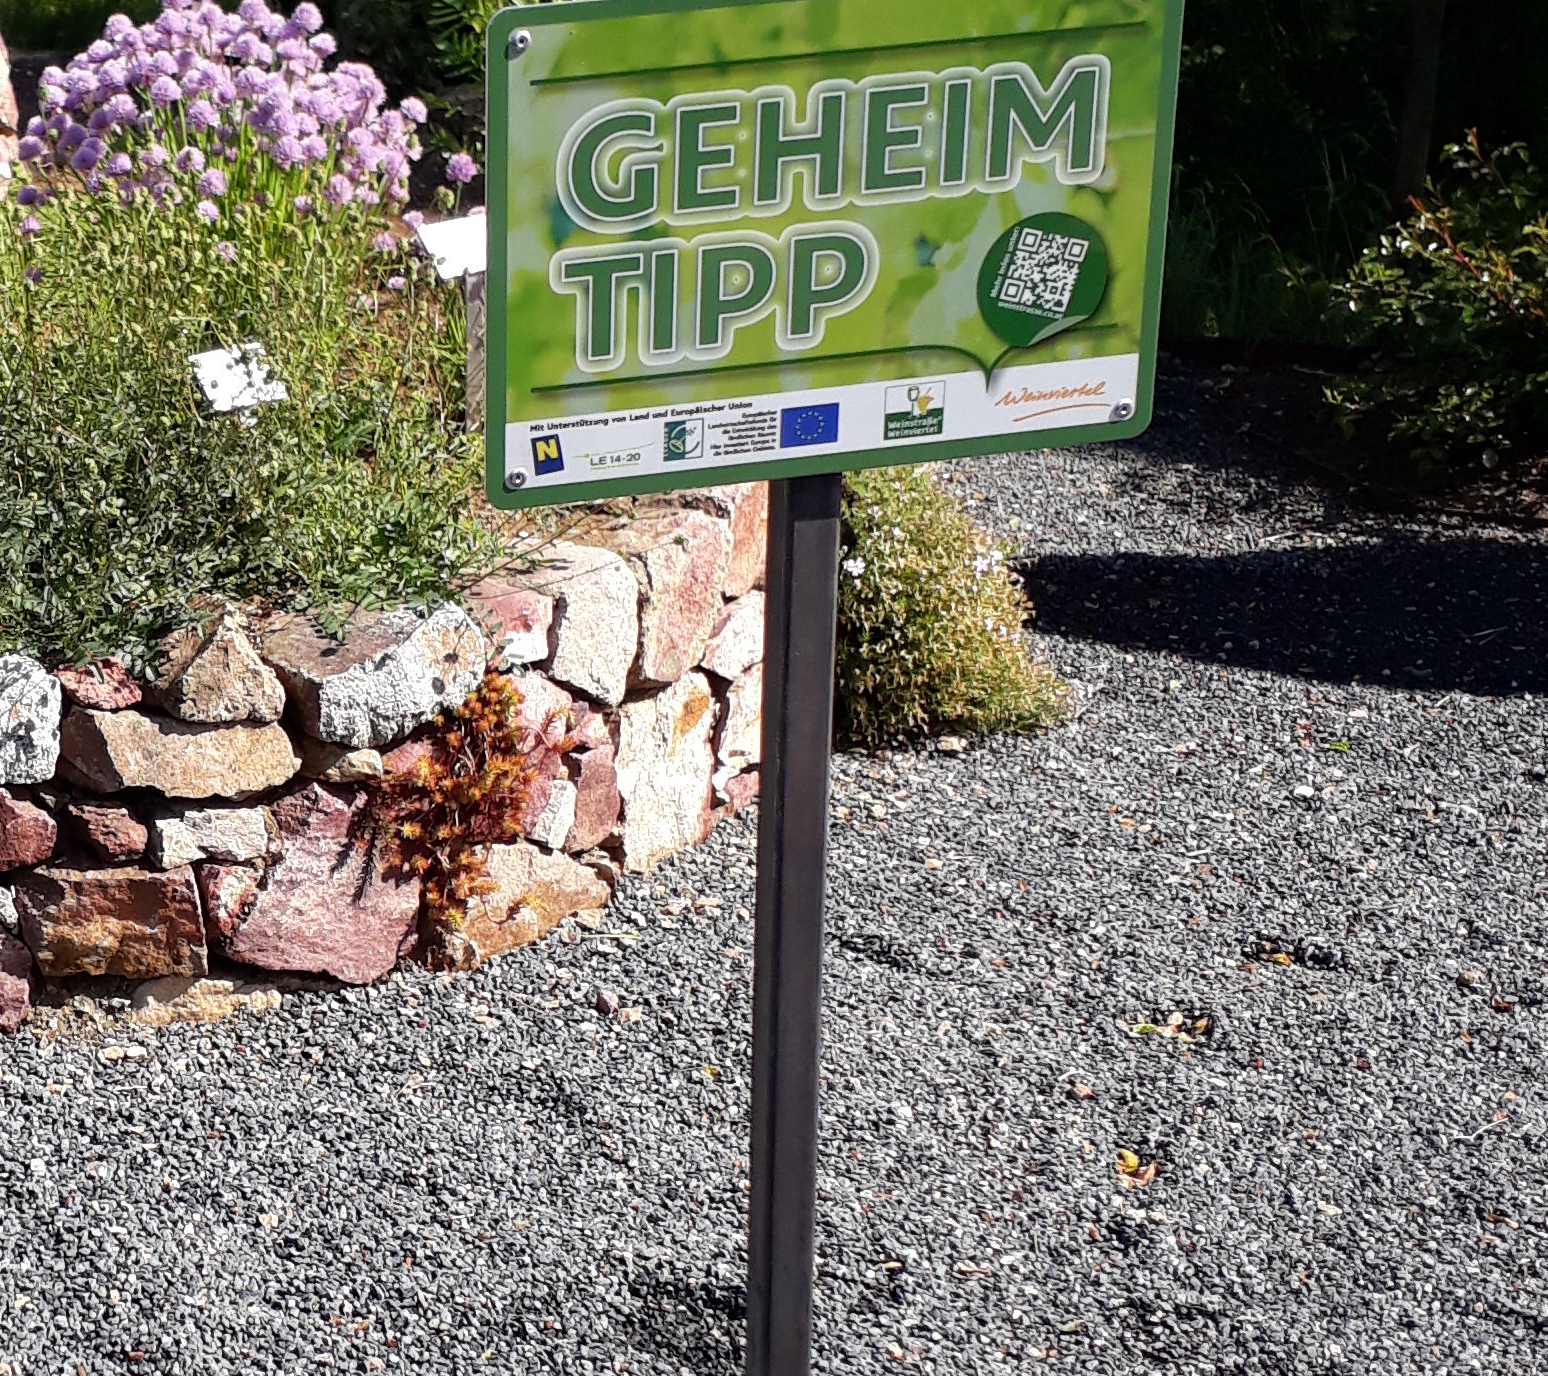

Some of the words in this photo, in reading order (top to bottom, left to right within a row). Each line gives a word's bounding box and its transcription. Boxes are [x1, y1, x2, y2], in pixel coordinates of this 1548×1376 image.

[566, 65, 1101, 222] GEHEIM
[560, 230, 868, 361] TIPP
[993, 381, 1107, 407] Weinviertel
[547, 418, 609, 430] Unterstützung
[629, 412, 650, 422] Land
[652, 409, 668, 419] und
[671, 404, 726, 416] Europäischer
[728, 401, 753, 410] Union
[535, 438, 559, 462] N
[590, 456, 607, 466] LE
[609, 452, 642, 464] 14-20
